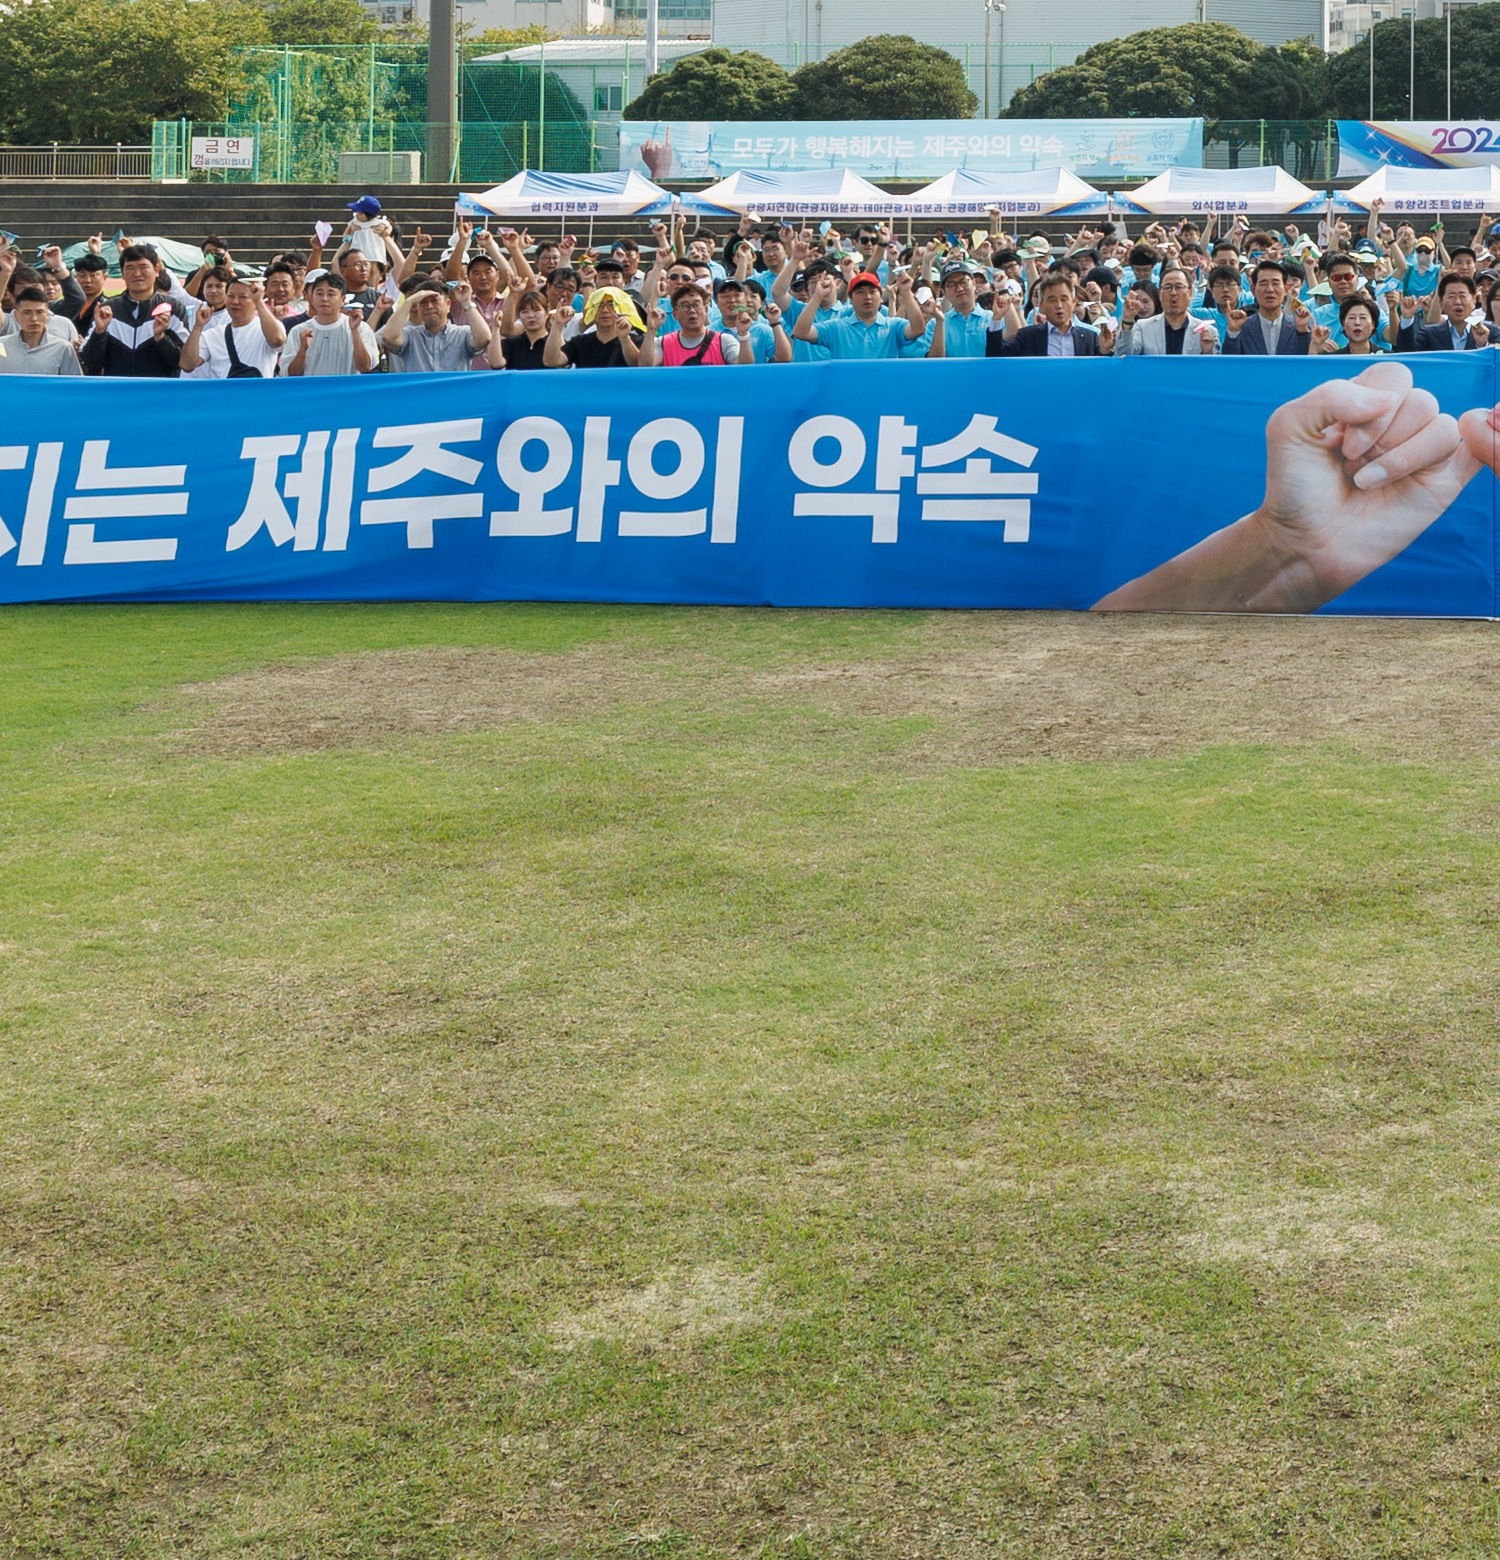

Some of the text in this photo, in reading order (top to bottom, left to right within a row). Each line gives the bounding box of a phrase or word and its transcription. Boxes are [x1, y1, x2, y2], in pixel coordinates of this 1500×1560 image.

[731, 134, 1065, 160] 모두가 행복해지는 제주와의 약속
[531, 201, 599, 213] 협력지원분과
[746, 201, 1041, 214] 관광지연합(관광지업분과·테마관광지업분과·관광해양저업분과)
[1191, 200, 1248, 211] 외식업분과
[1394, 199, 1485, 210] 휴양리조트업분과
[226, 416, 744, 551] 제주와의
[789, 414, 1038, 542] 약속
